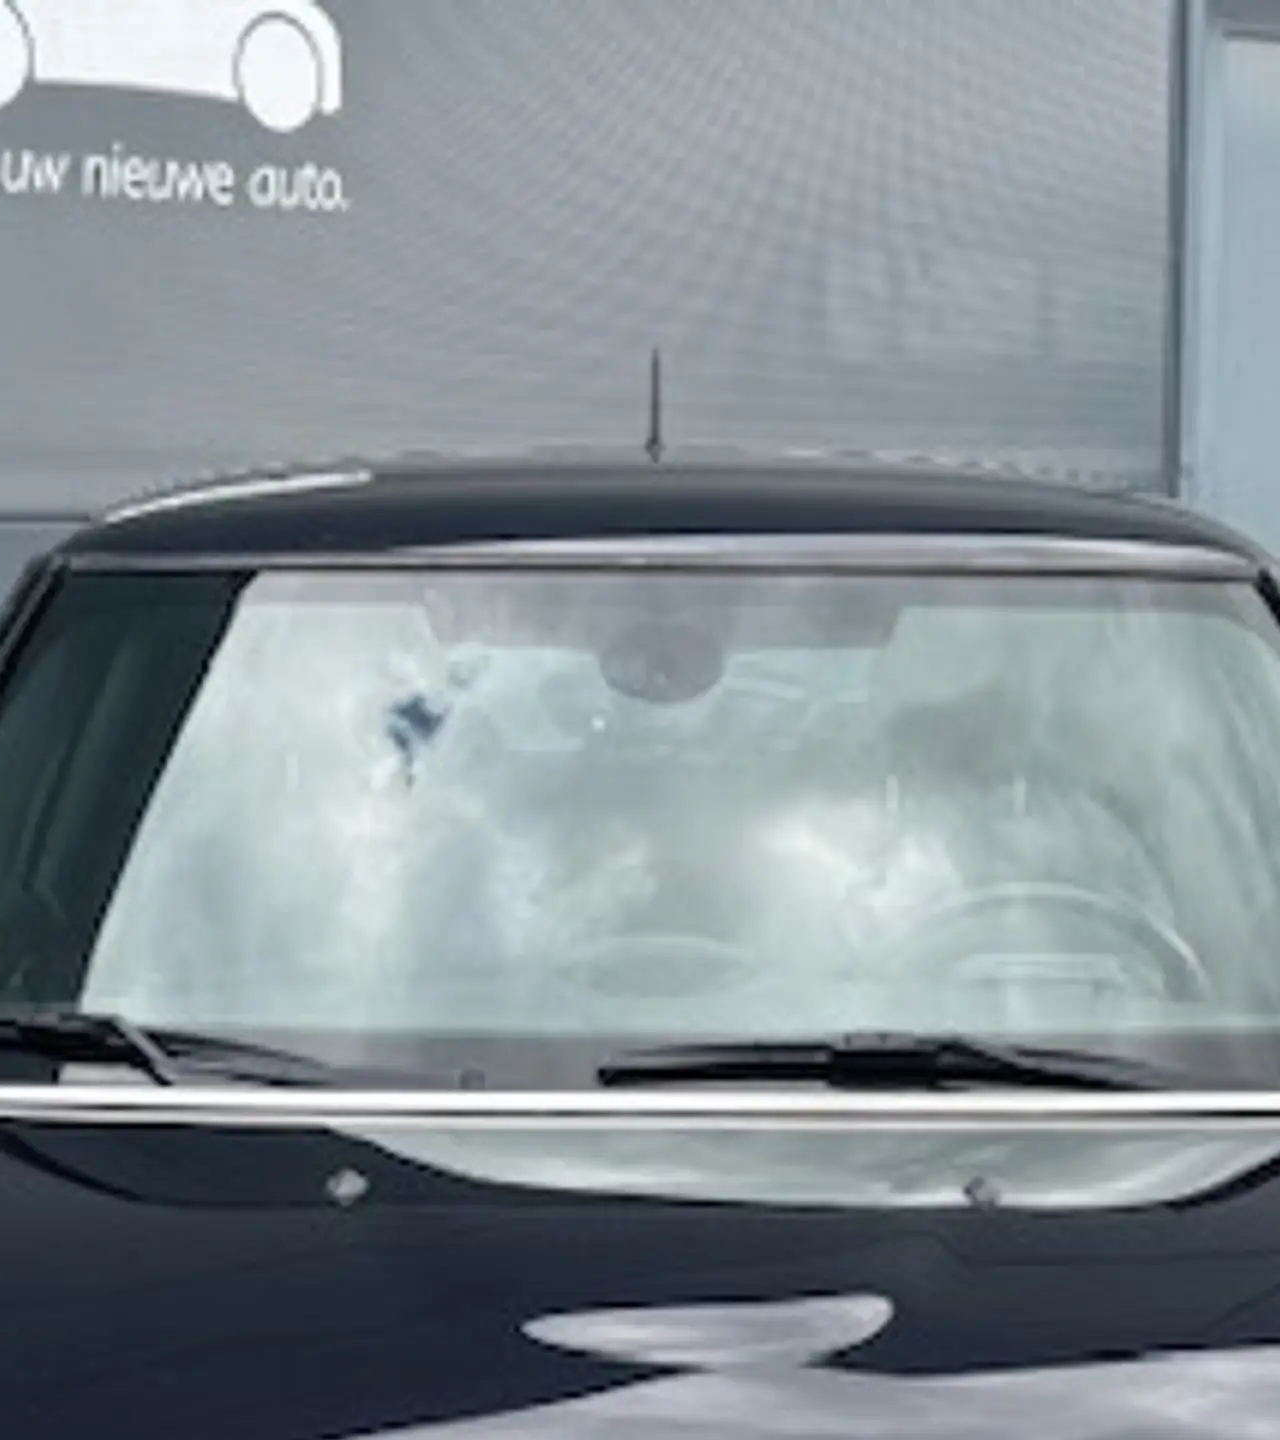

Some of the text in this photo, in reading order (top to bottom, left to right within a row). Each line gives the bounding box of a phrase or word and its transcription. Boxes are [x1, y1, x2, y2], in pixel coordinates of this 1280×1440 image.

[0, 148, 71, 194] uw
[81, 142, 234, 205] nieuwe
[247, 161, 351, 213] auto.
